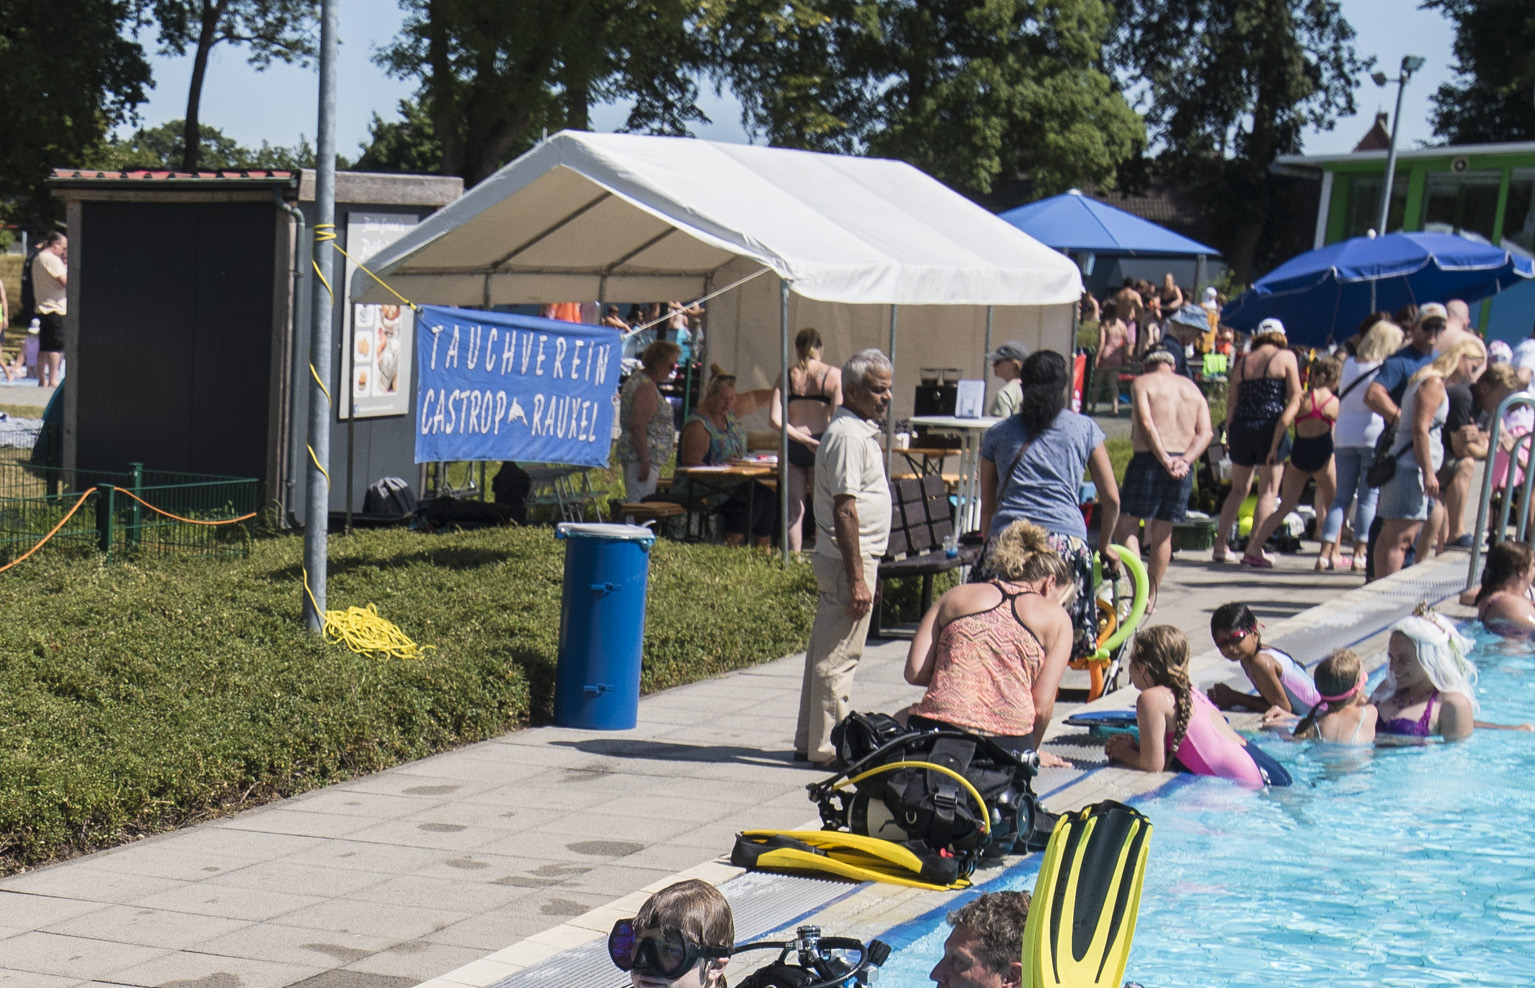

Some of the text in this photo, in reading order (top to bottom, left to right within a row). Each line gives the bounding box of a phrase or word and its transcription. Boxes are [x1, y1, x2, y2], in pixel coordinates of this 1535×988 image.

[430, 323, 611, 386] TAUCHVEREIN
[421, 388, 599, 442] CASTROP RAUXEL
